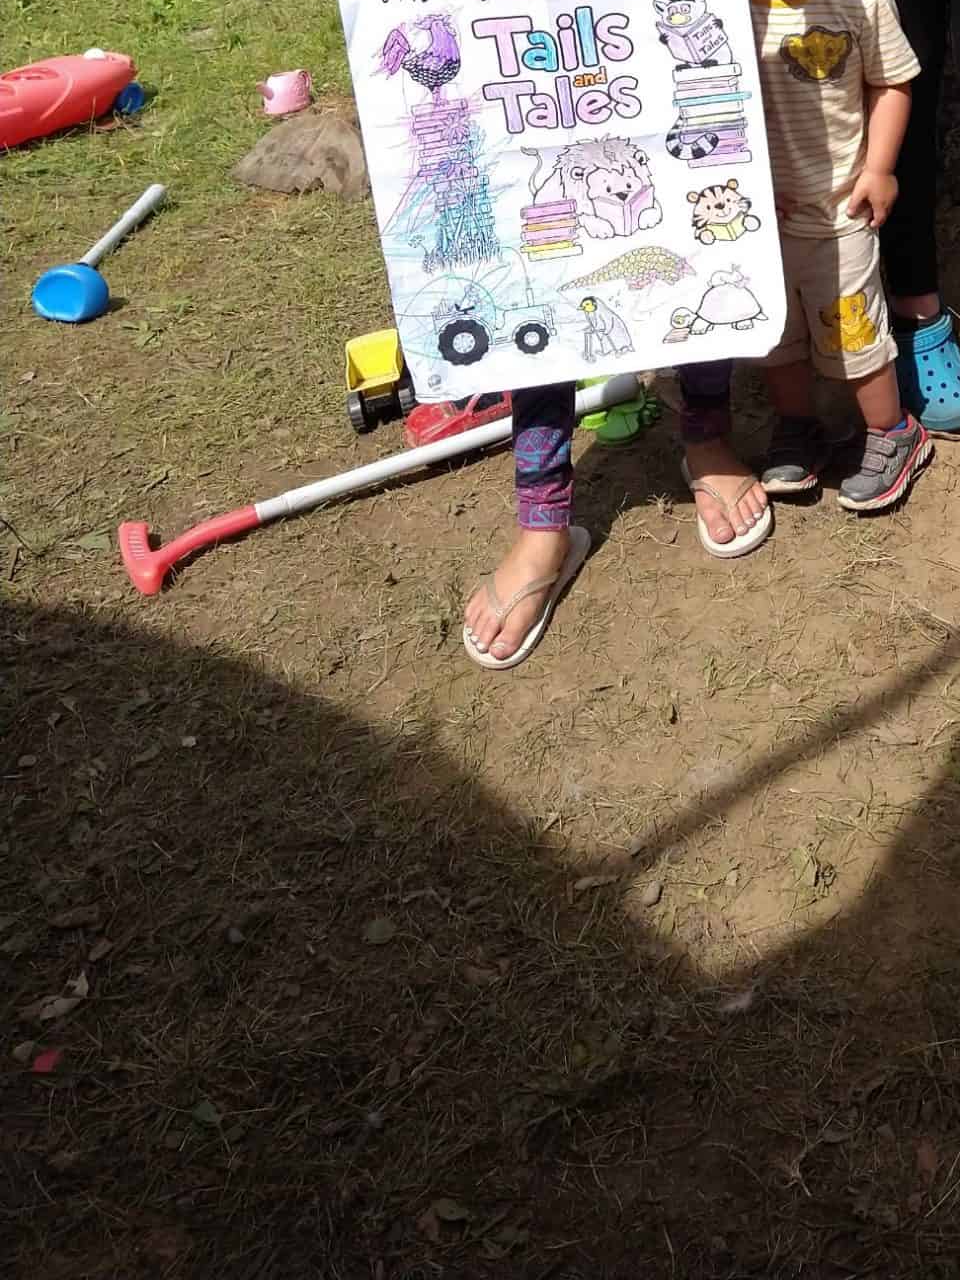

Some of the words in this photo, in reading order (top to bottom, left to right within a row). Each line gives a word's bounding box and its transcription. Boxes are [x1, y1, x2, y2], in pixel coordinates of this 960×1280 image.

[472, 6, 635, 78] Tails
[482, 74, 643, 134] Tales
[573, 67, 608, 89] and
